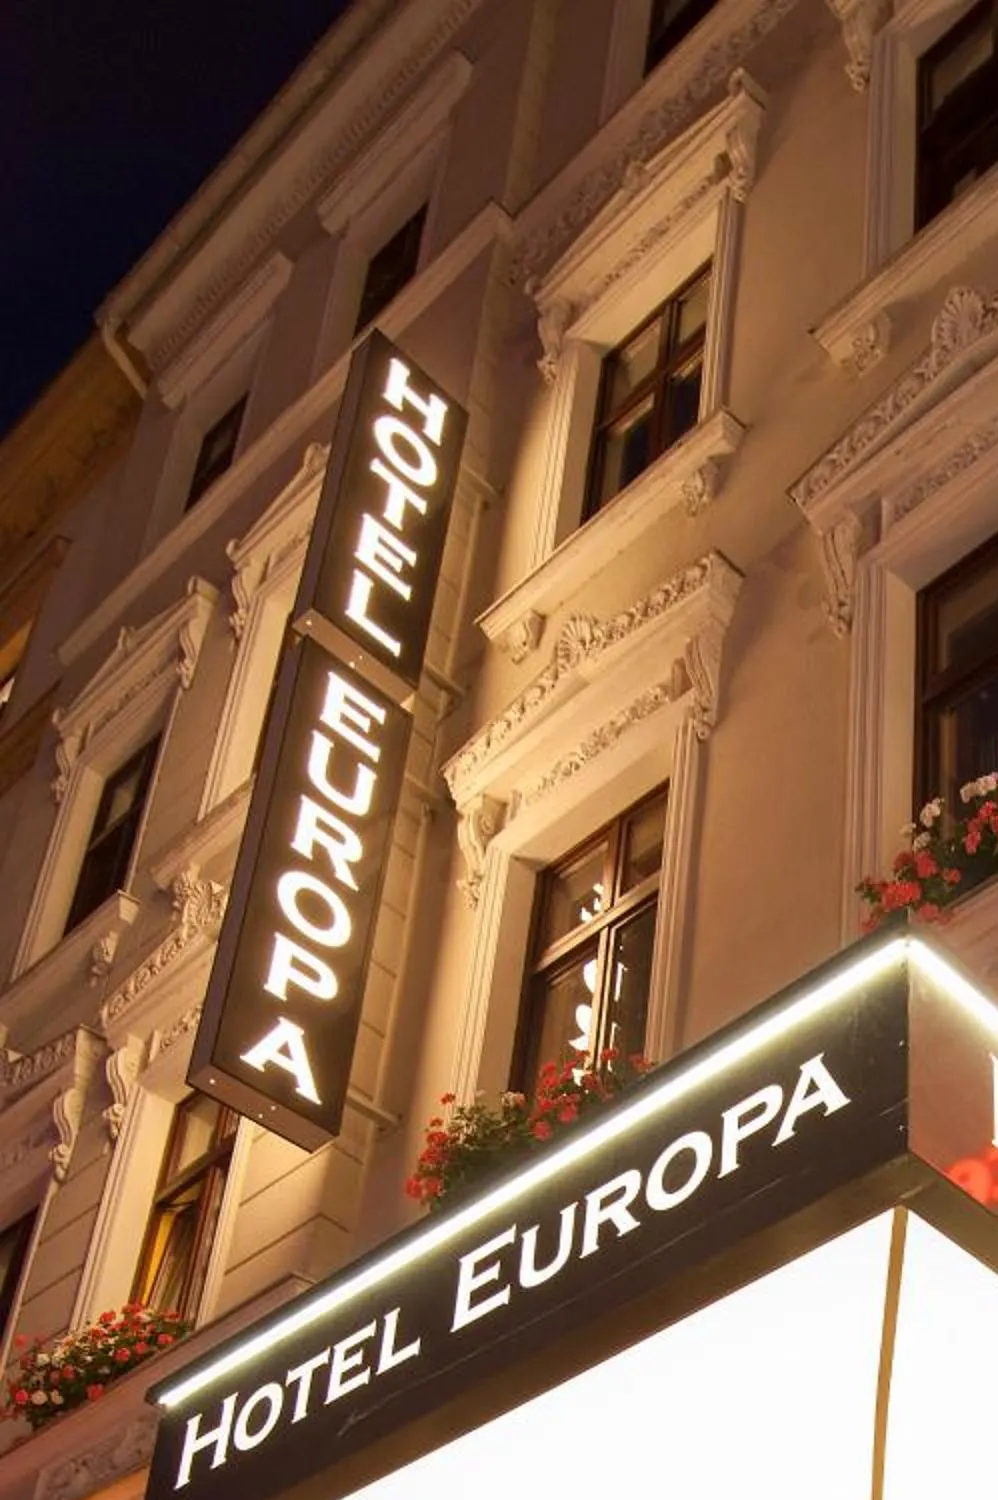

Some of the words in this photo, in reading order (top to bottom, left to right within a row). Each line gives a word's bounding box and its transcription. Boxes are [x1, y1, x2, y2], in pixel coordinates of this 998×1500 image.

[344, 356, 449, 657] HOTEL
[239, 670, 386, 1106] EUROPA
[174, 1305, 422, 1491] HOTEL
[449, 1052, 852, 1334] EUROPA
